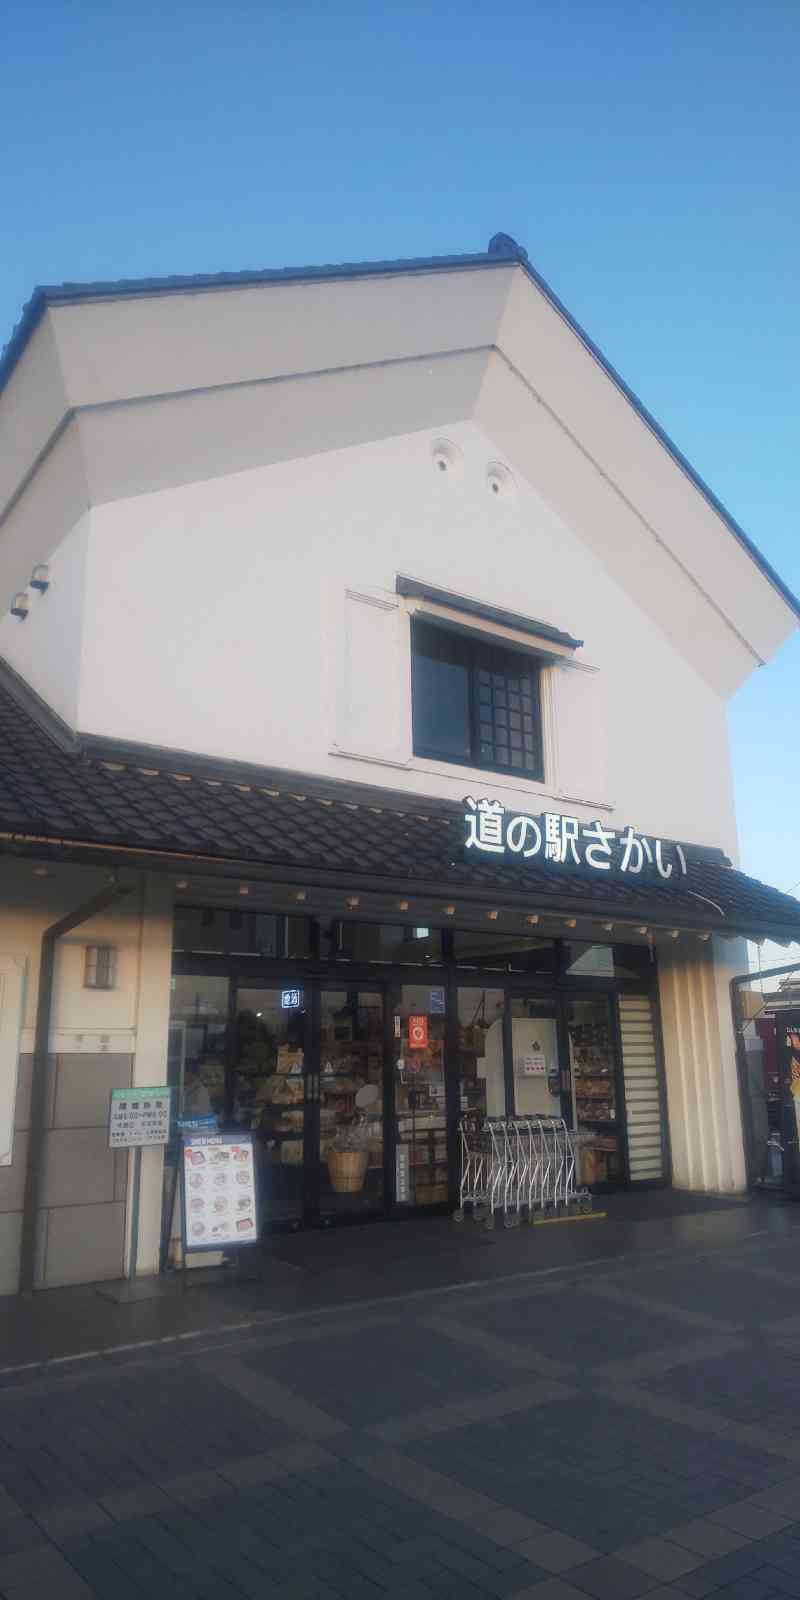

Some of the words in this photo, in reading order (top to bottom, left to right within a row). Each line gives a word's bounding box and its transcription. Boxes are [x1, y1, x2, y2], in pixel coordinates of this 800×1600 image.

[463, 797, 687, 879] 道の駅さかい
